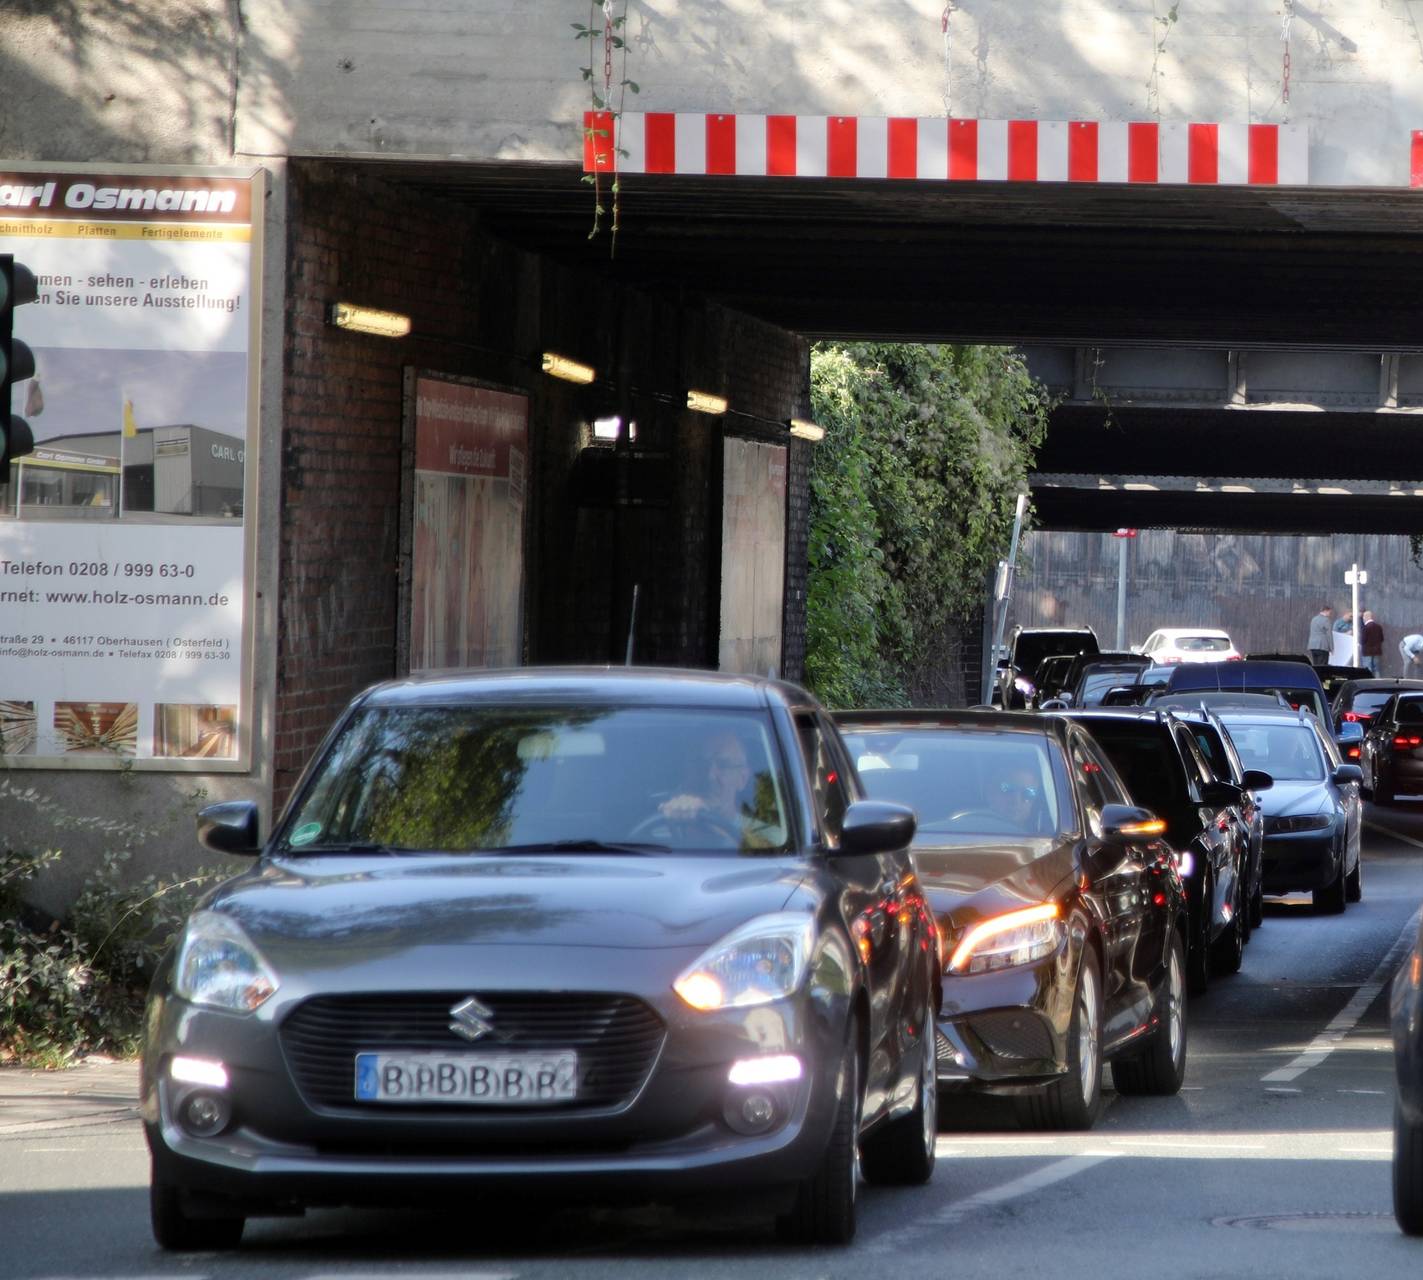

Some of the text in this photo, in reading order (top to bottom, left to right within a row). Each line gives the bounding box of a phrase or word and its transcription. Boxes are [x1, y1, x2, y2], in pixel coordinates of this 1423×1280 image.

[64, 183, 237, 213] Osmann
[78, 225, 117, 237] Platten
[142, 227, 223, 240] Fertigelemente
[88, 274, 134, 289] sehen
[150, 275, 208, 291] erleben
[56, 291, 80, 306] Sie
[86, 295, 137, 307] unsere
[142, 292, 240, 313] Ausstellung!
[1, 560, 63, 576] Telefon
[69, 562, 108, 576] 0208
[124, 563, 153, 577] 999
[159, 564, 194, 578] 63-0
[46, 590, 229, 606] www.holz-osmann.de
[31, 635, 44, 645] 29
[63, 635, 94, 646] 46117
[97, 635, 163, 647] Oberhausen
[119, 649, 151, 658] Telefax
